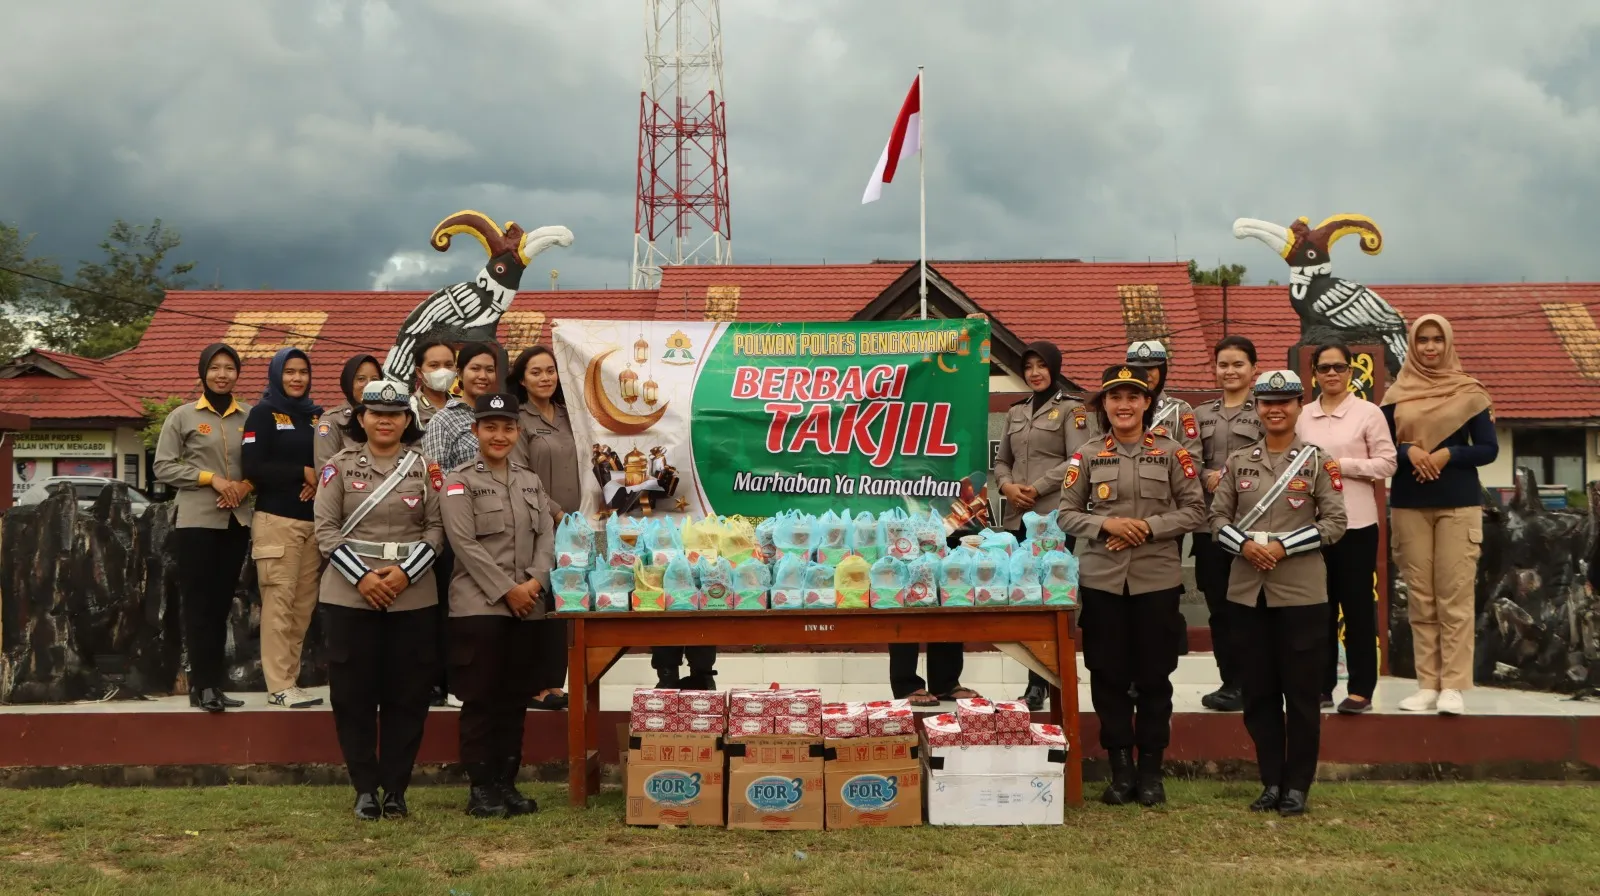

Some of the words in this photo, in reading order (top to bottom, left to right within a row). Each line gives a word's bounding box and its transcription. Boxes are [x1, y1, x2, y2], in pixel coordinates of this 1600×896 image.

[733, 333, 796, 356] POLWAN
[800, 332, 856, 356] POLRES
[859, 330, 958, 355] BENGKAYANG
[731, 364, 908, 402] BERBAGI
[764, 401, 958, 467] TAKJIL
[39, 442, 65, 451] UNTUK
[66, 442, 106, 451] MENGABDI
[1091, 457, 1120, 467] PARIANI
[1139, 456, 1169, 465] POLRI
[346, 469, 373, 481] NOVI
[1237, 467, 1260, 477] SETA
[733, 472, 831, 494] Marhaban
[834, 474, 855, 495] Ya
[858, 475, 961, 498] Ramadhan
[472, 488, 497, 497] SINTA
